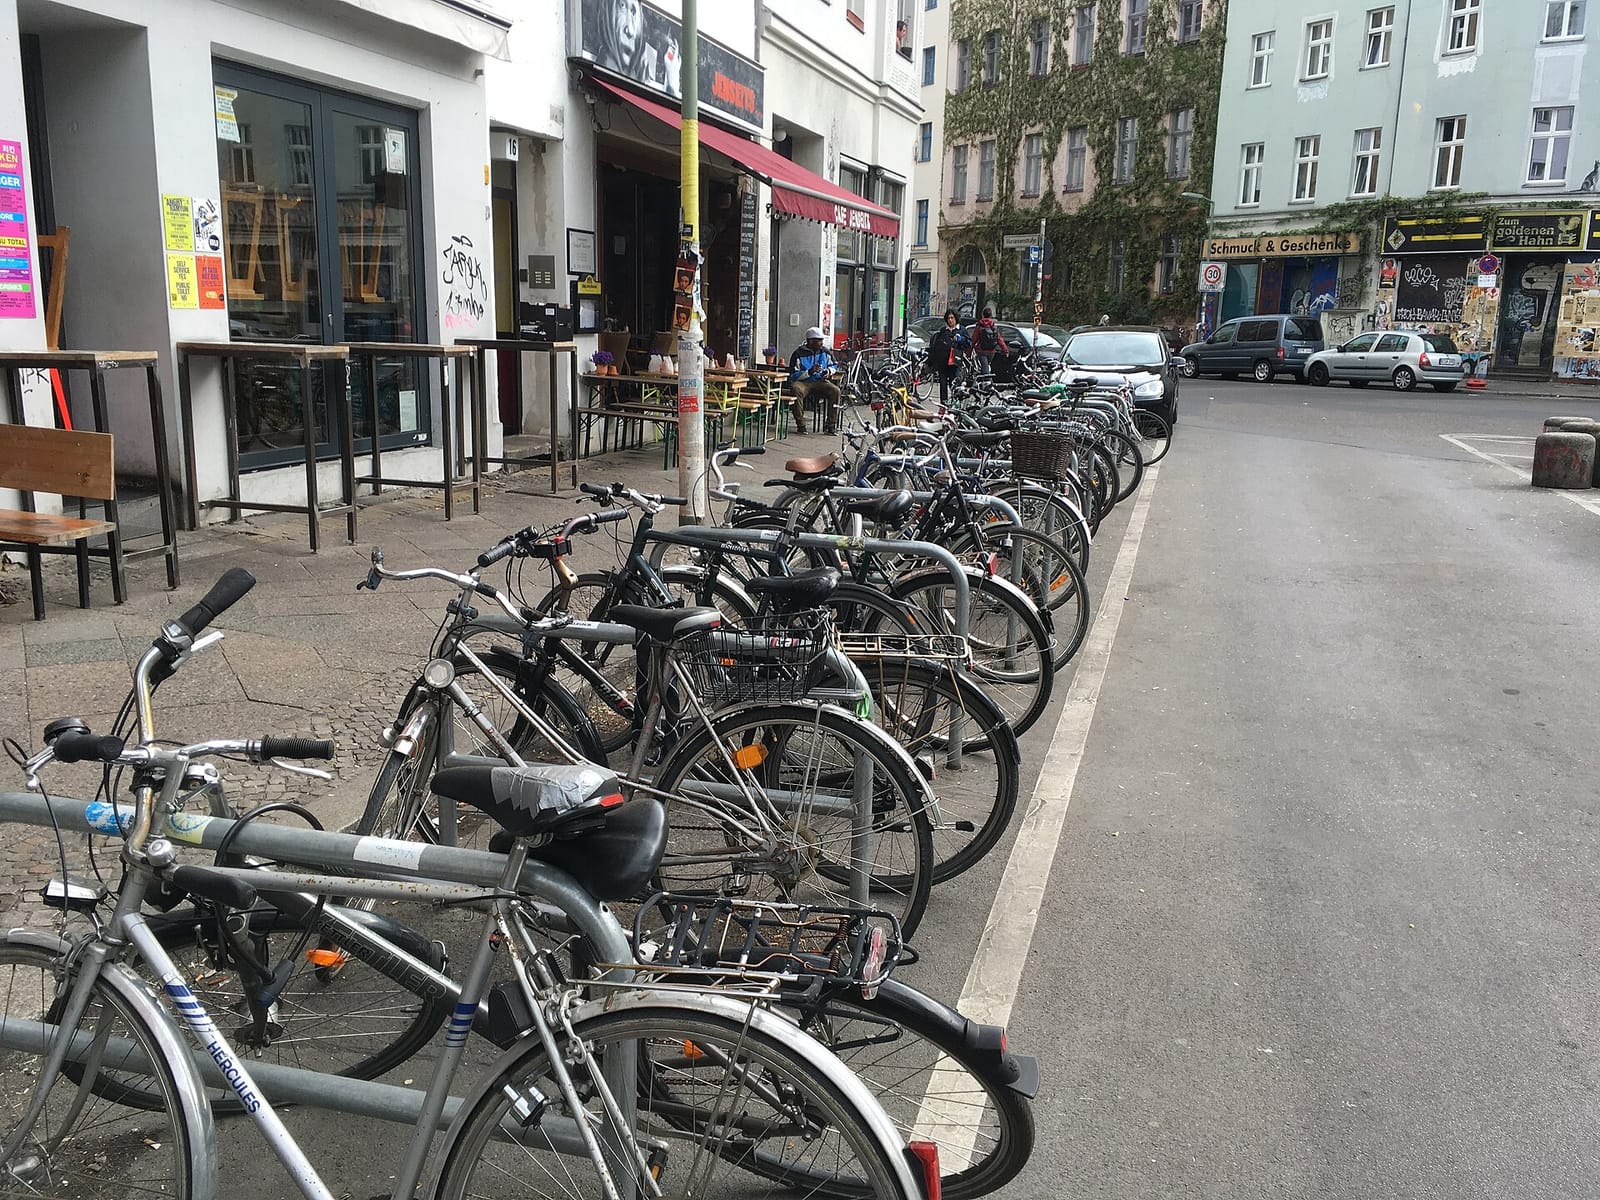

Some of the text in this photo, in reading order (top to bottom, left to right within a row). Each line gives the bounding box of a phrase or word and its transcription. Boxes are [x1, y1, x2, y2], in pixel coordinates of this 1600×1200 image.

[509, 138, 517, 156] 16
[1497, 217, 1520, 226] Zum
[1496, 225, 1555, 237] goldenen
[7, 238, 26, 246] TOTAL
[1210, 234, 1352, 255] Schmuck & Geschenke
[1518, 235, 1554, 246] Hahn
[1208, 269, 1219, 279] 30
[206, 1040, 261, 1113] HERCULES
